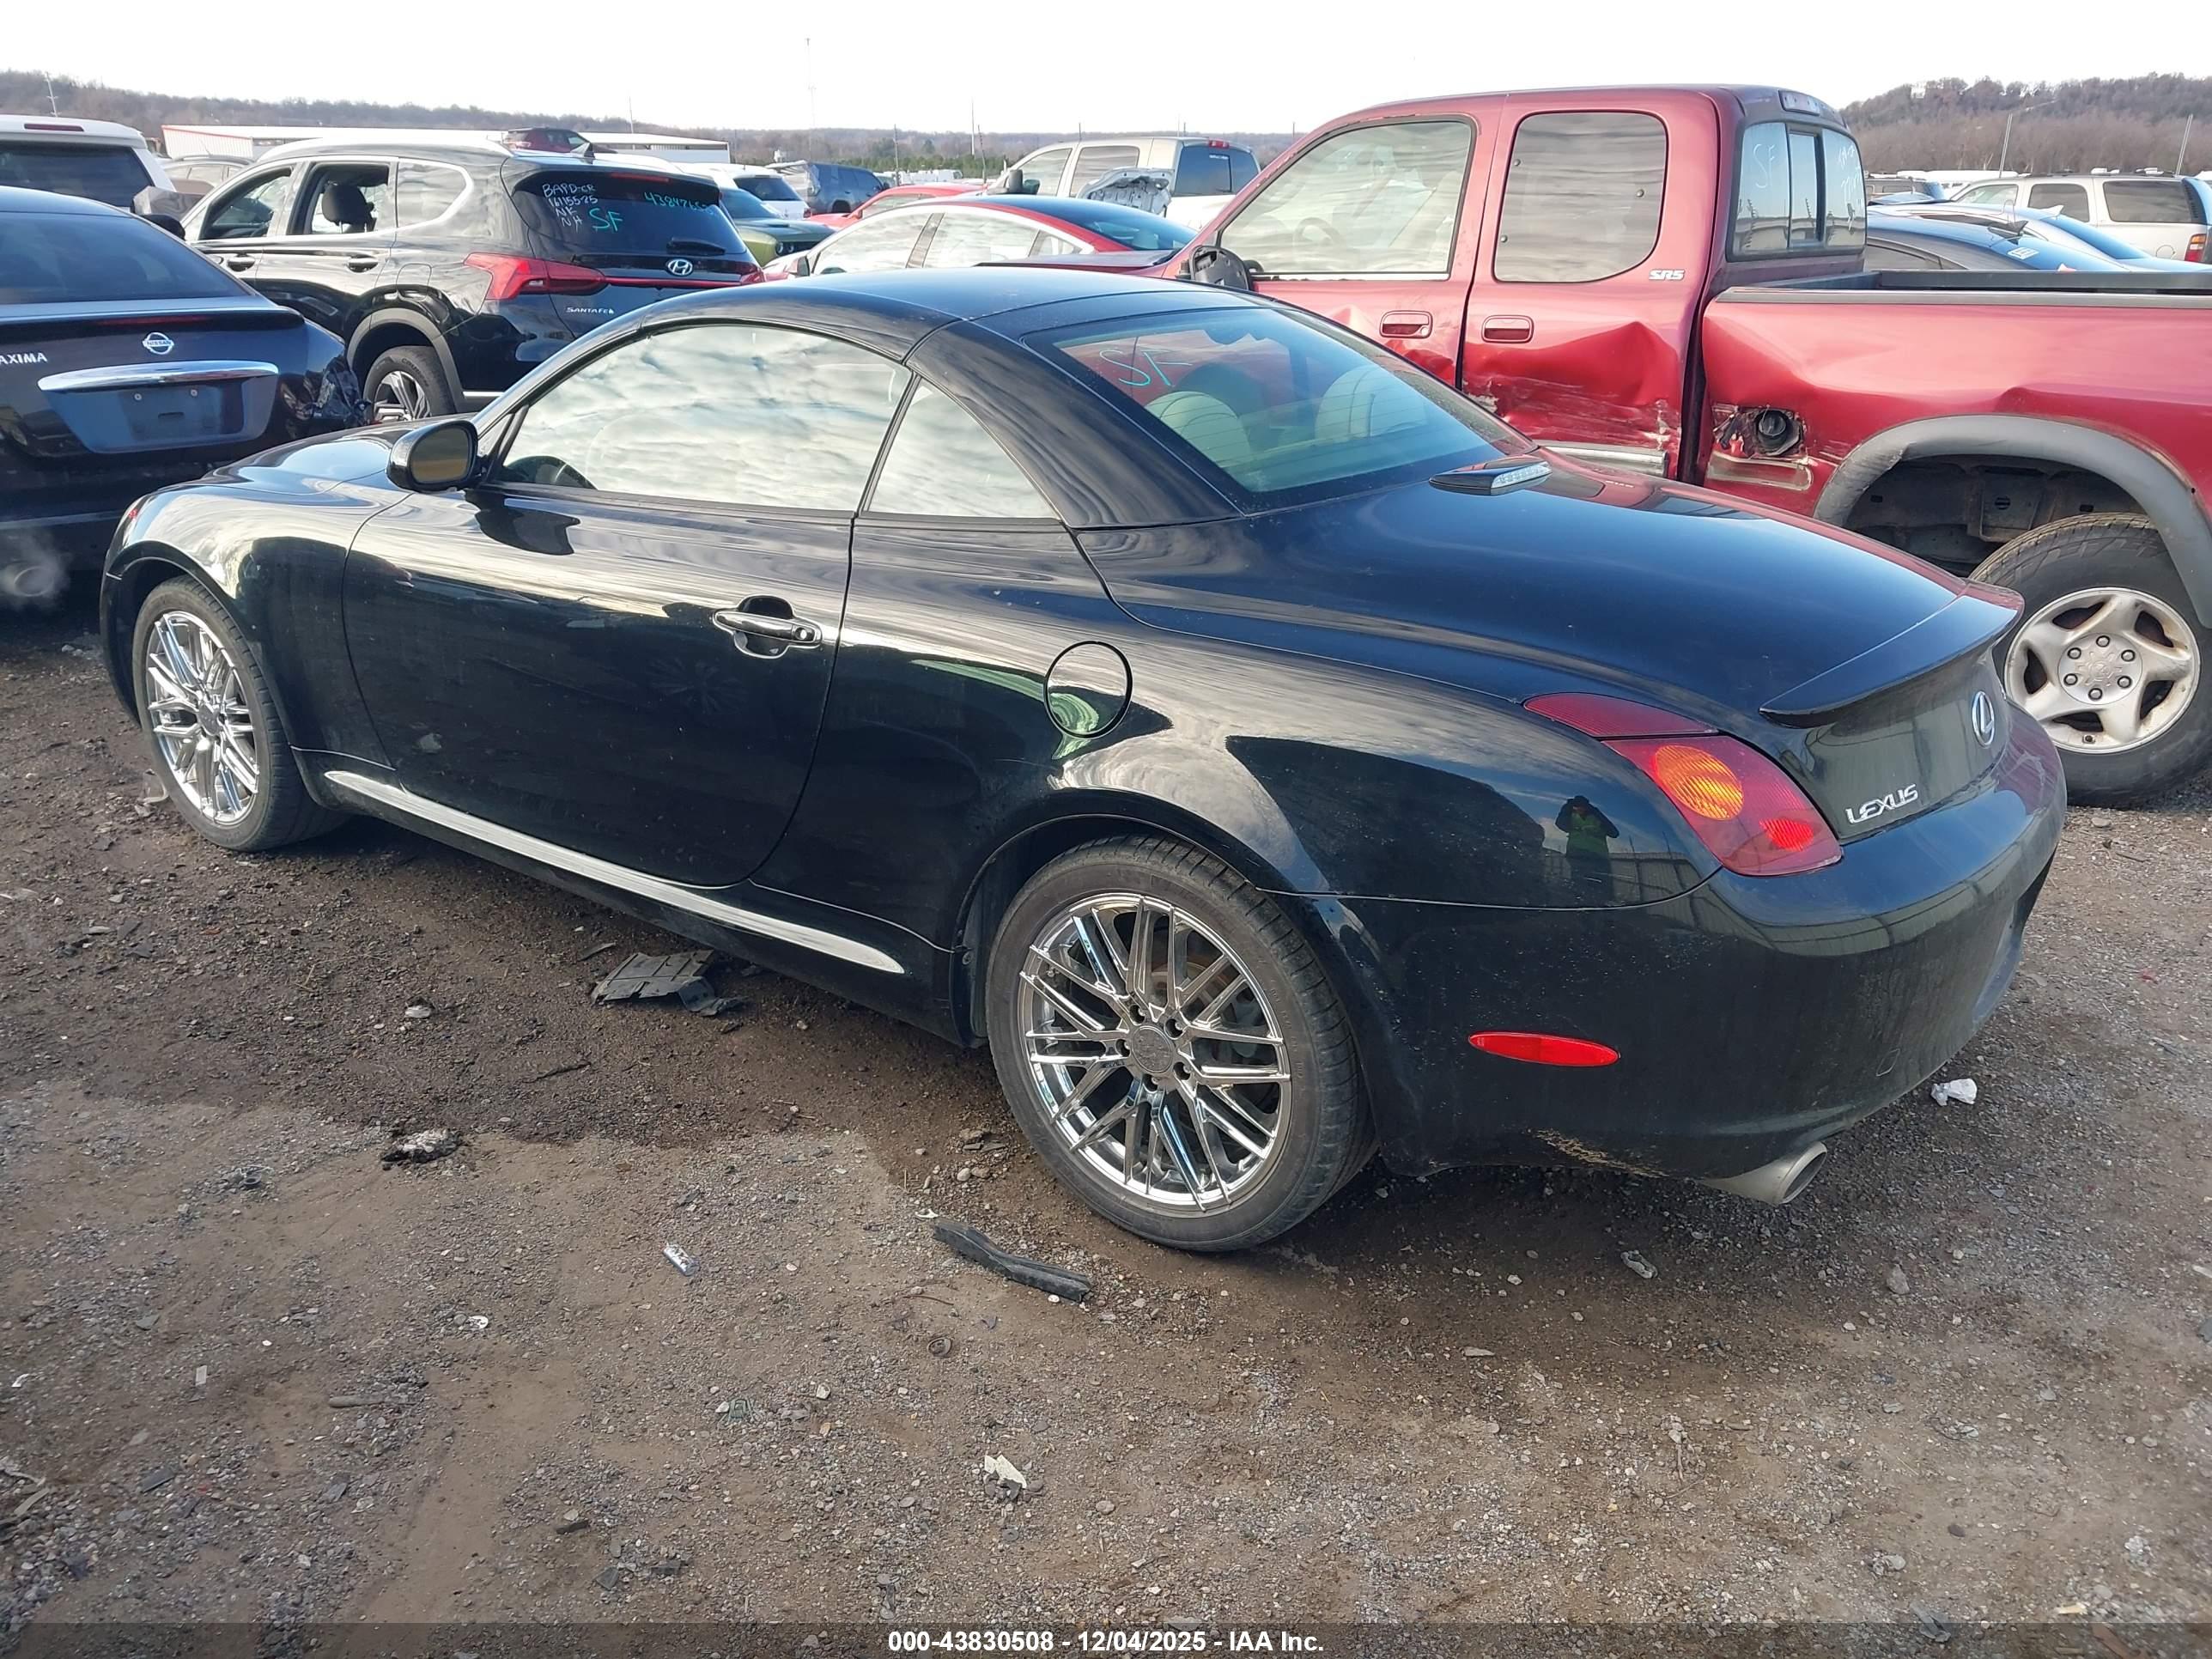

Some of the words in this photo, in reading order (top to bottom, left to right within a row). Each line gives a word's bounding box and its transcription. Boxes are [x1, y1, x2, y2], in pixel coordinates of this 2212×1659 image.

[588, 208, 623, 232] SF
[1648, 269, 1686, 282] SR5
[1098, 348, 1194, 387] SF
[1845, 782, 1919, 824] LEXUS
